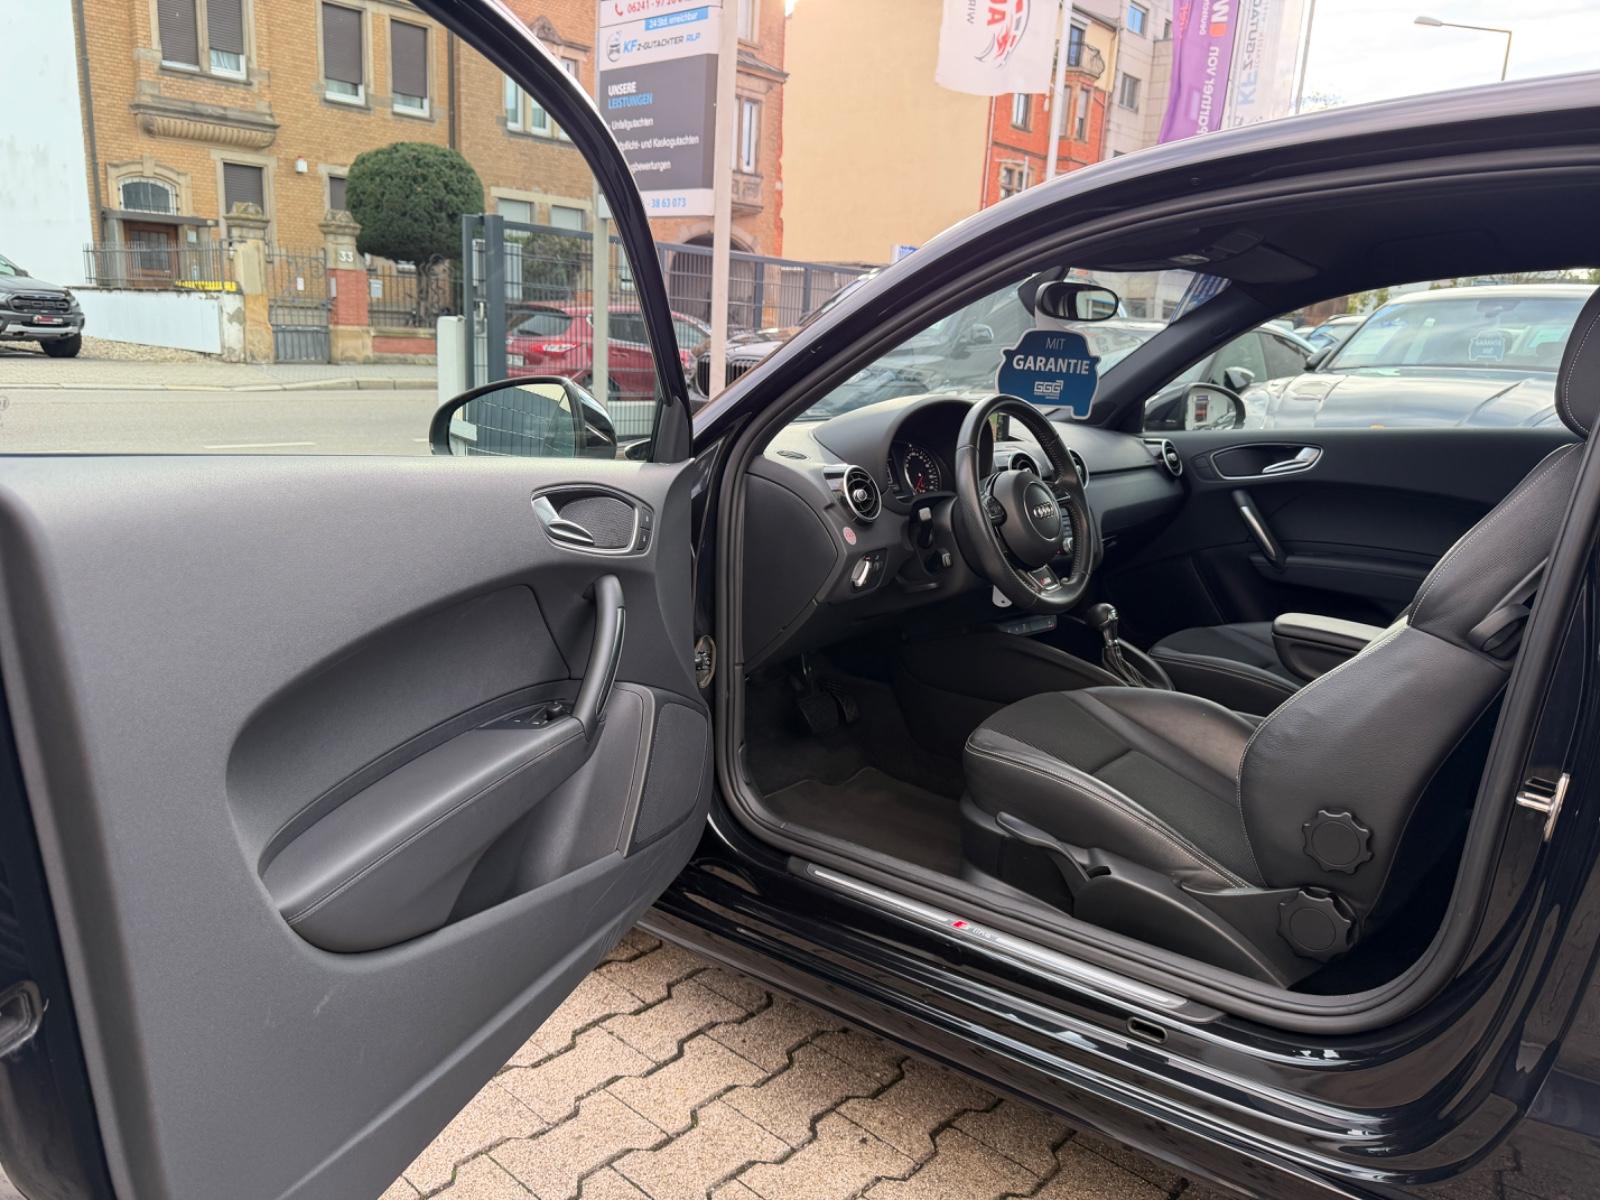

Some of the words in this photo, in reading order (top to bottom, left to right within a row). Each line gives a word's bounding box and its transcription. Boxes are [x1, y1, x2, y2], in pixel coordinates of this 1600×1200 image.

[608, 81, 636, 96] UNSERE
[608, 92, 653, 110] LEISTUNGEN
[640, 138, 652, 149] und
[339, 250, 354, 263] 33
[1046, 337, 1066, 350] MIT
[1013, 354, 1091, 375] GARANTIE
